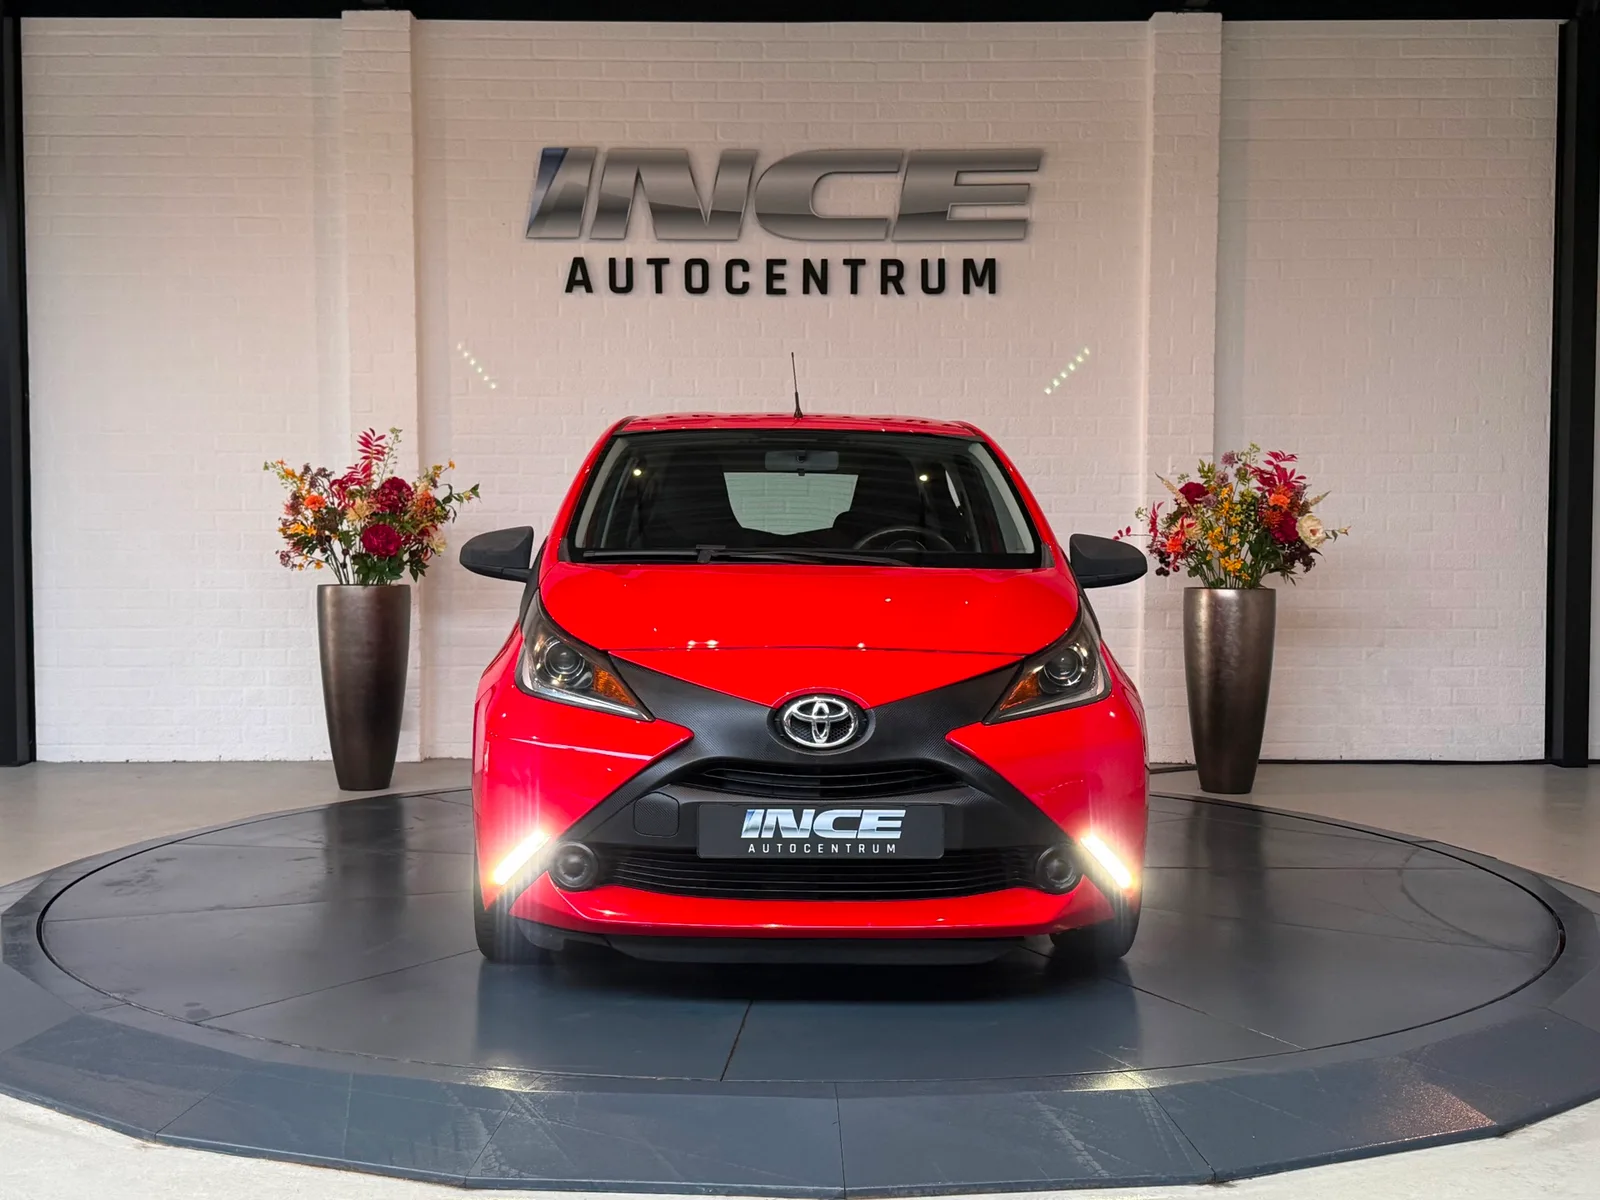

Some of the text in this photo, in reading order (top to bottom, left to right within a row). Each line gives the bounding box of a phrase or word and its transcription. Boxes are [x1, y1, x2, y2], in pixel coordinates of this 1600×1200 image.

[526, 147, 1044, 242] INCE
[565, 256, 997, 295] AUTOCENTRUM
[741, 809, 906, 838] INCE
[748, 843, 896, 853] AUTOCENTRUM
